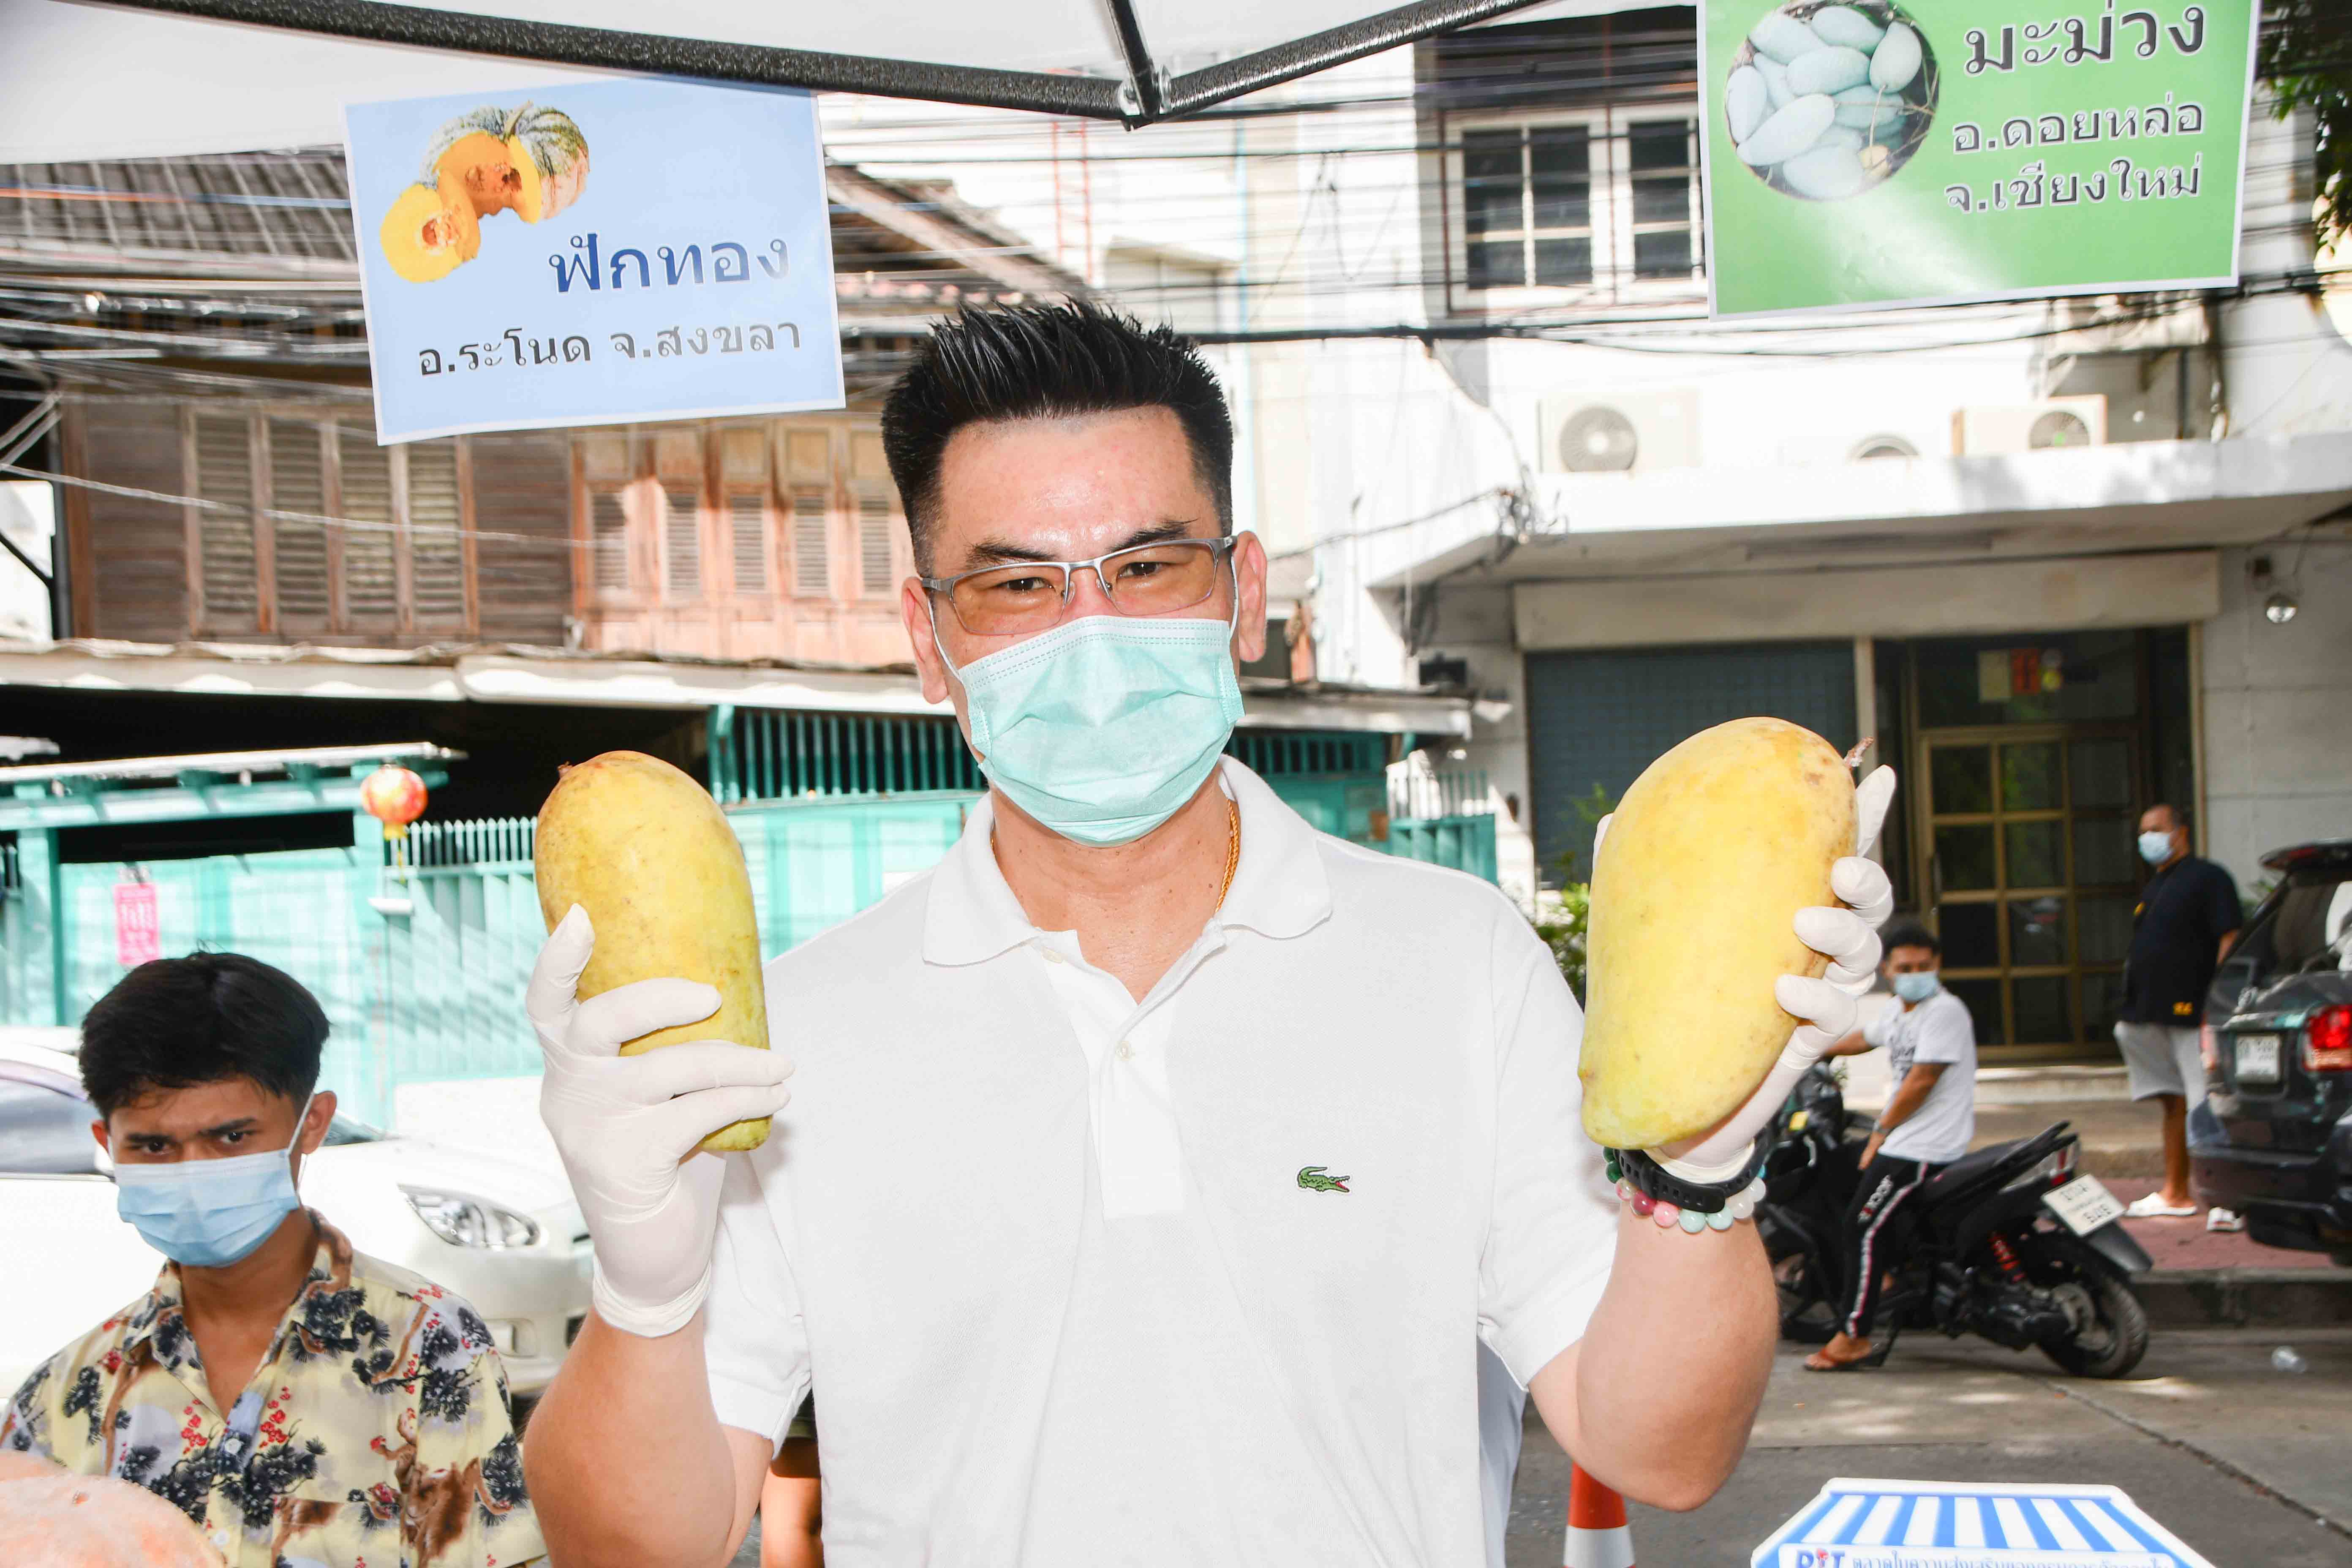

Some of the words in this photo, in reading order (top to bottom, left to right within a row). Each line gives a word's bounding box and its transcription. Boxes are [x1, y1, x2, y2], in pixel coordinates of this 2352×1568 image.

[1965, 0, 2204, 75] มะม่วง
[1954, 94, 2202, 152] อ.ดอยหล่อ
[1946, 155, 2199, 211] จ.เชียงใหม่
[548, 232, 789, 293] ฟักทอง
[419, 327, 591, 376] อ.ระโนด
[610, 322, 800, 359] จ.สงขลา
